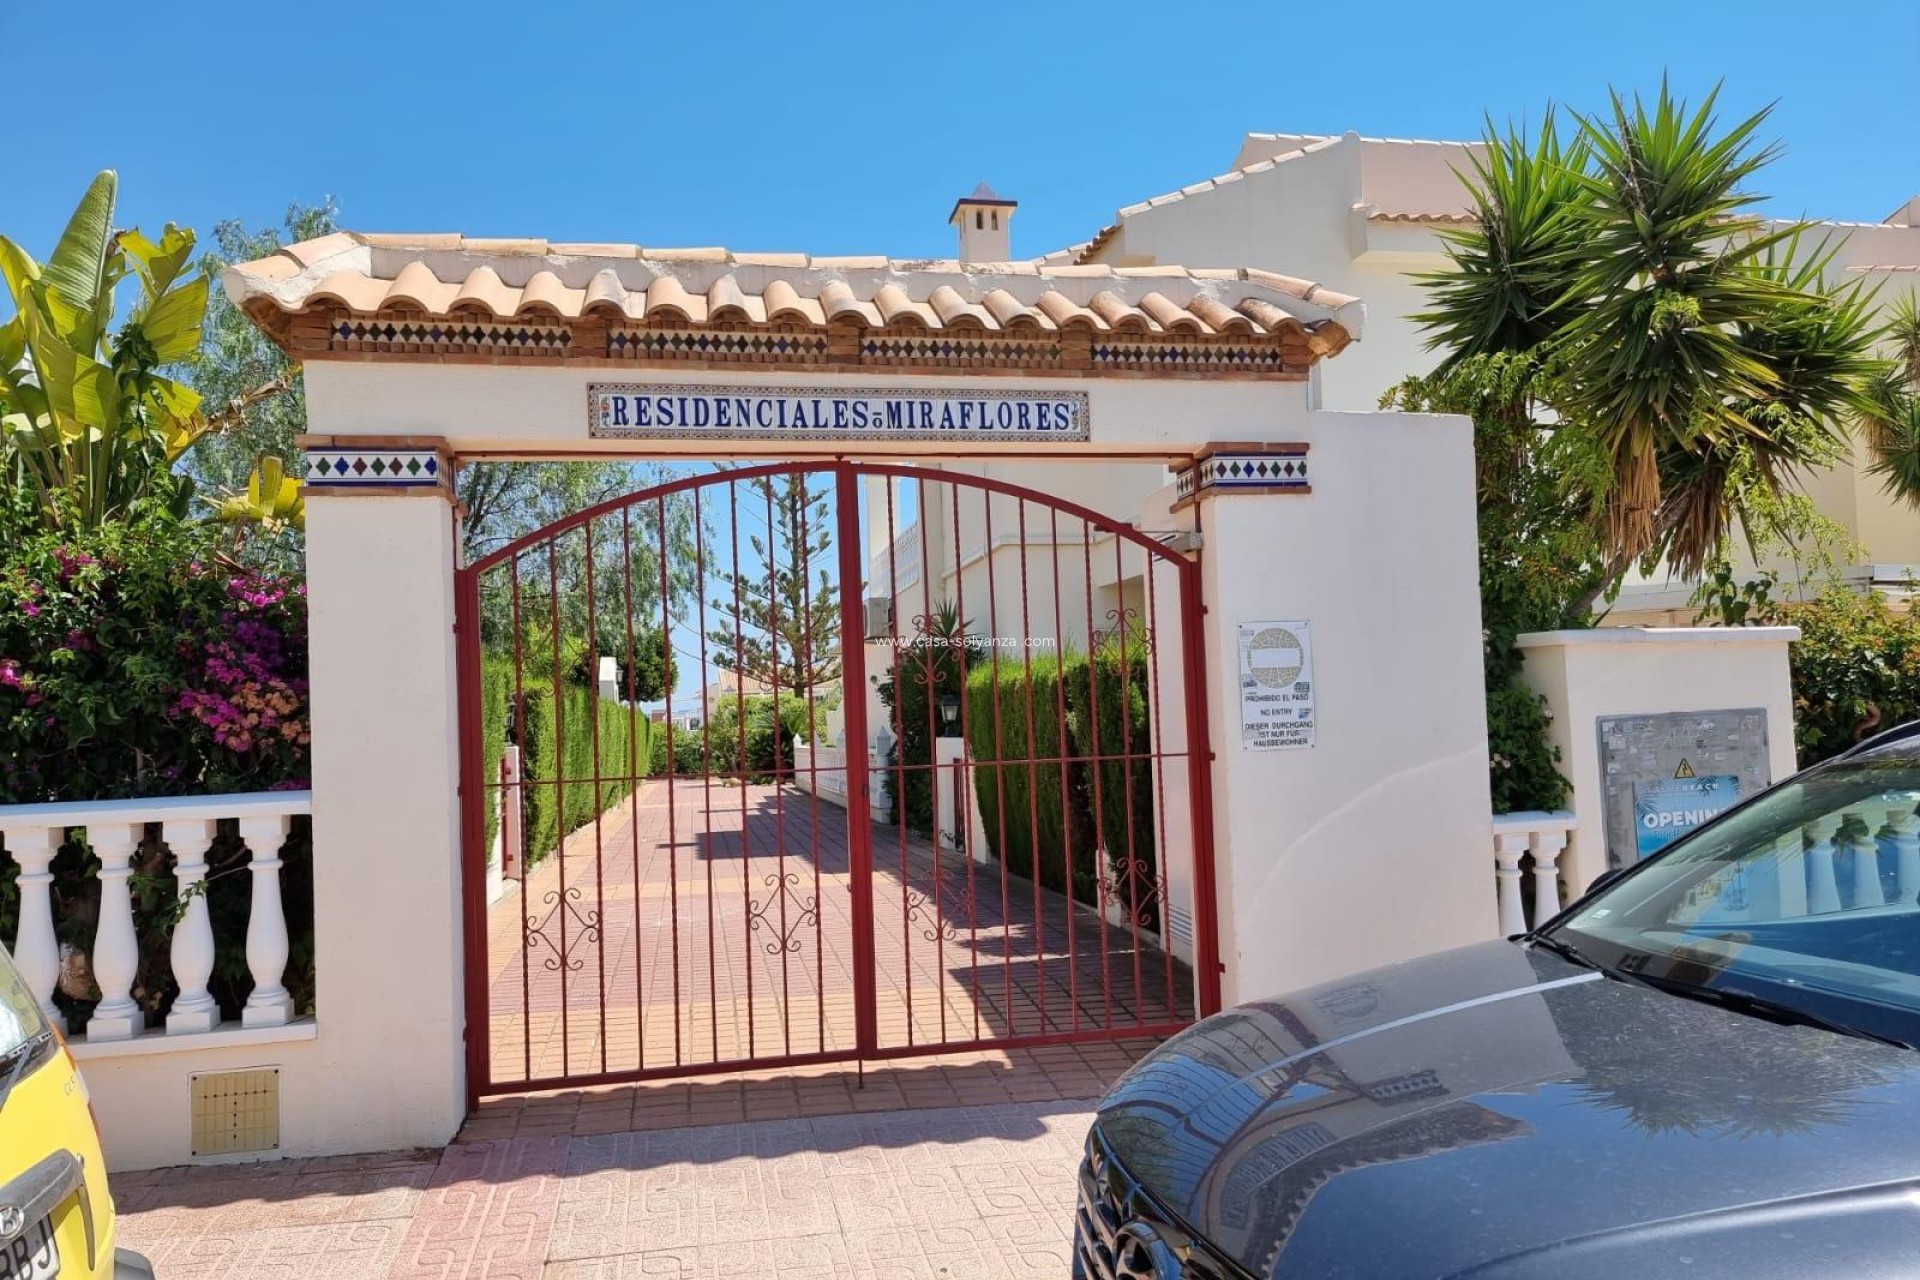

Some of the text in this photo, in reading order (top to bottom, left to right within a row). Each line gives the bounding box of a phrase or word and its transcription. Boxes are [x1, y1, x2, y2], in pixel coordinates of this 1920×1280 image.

[612, 396, 868, 429] RESIDENCIALES
[886, 400, 1070, 430] MIRAFLORES
[1245, 694, 1280, 702] PROHIBIDO
[1292, 693, 1309, 701] PASO
[1271, 708, 1292, 716] ENTRY
